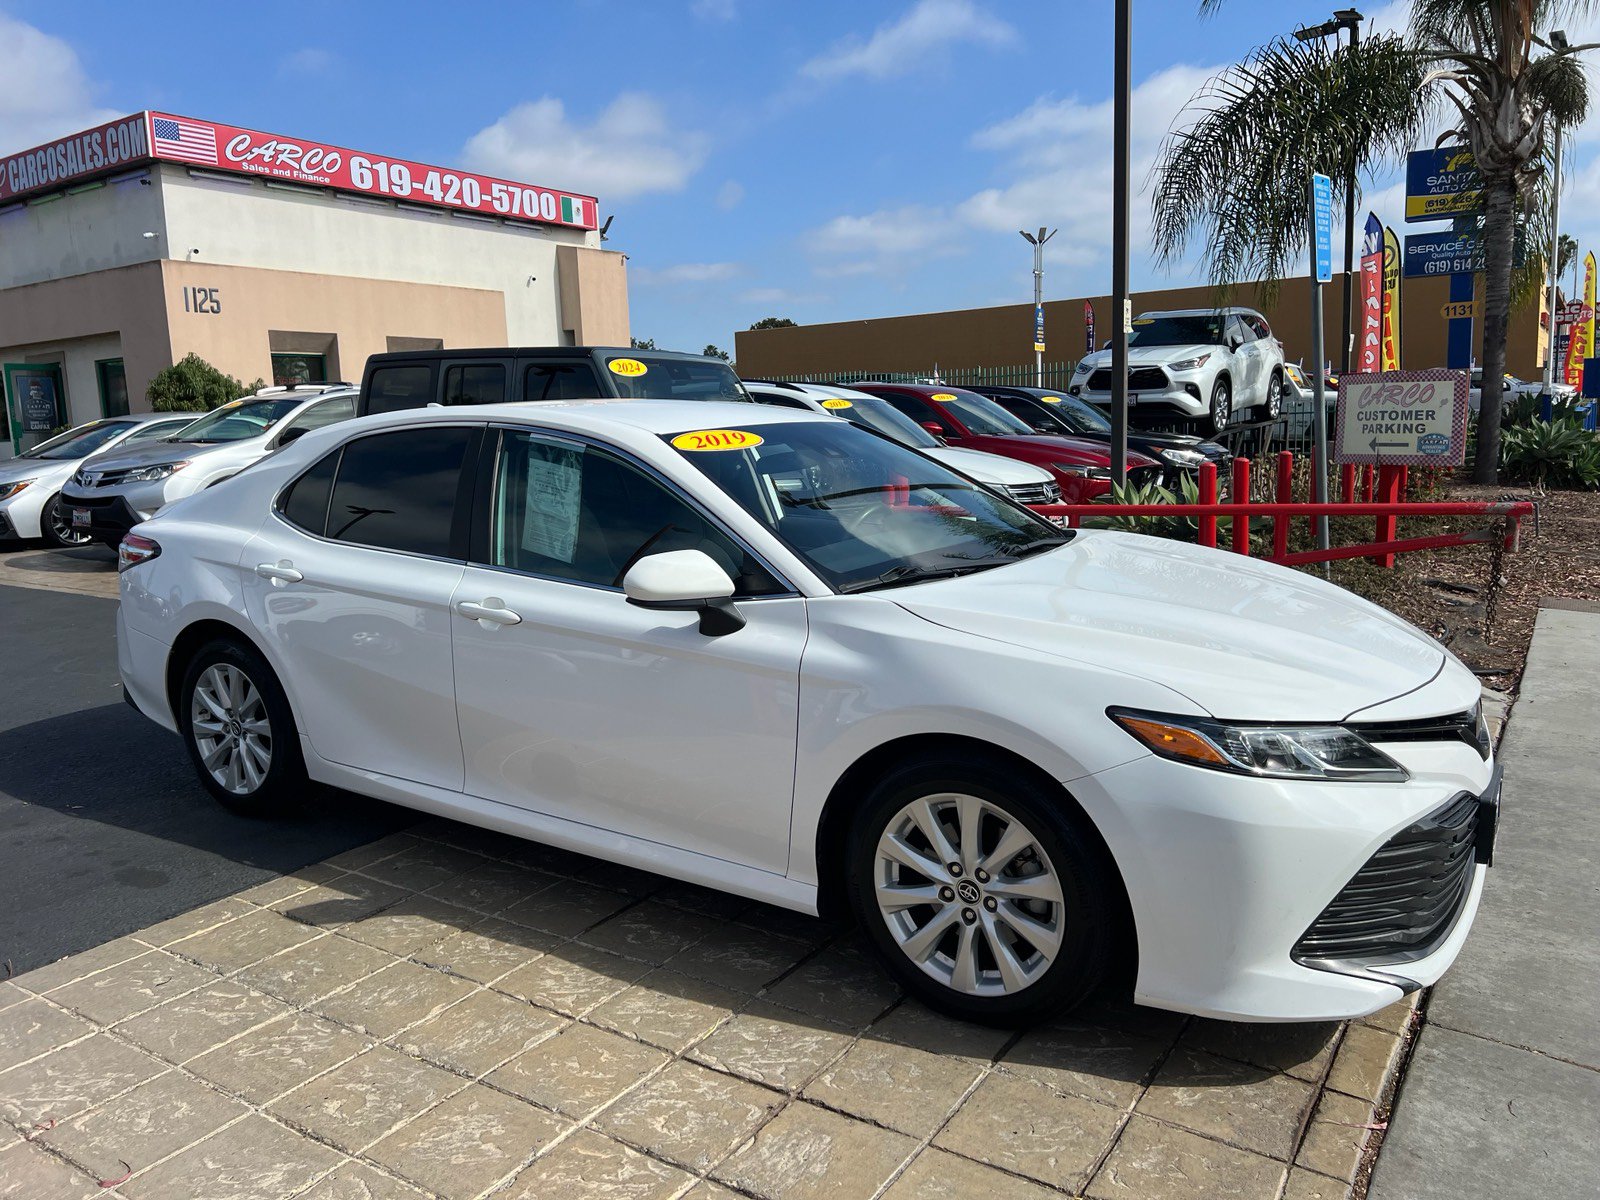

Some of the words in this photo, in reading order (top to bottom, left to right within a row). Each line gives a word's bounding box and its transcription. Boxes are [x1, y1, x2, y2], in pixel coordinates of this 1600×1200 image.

[8, 118, 147, 193] CARCOSALES.COM
[225, 133, 342, 174] CARCO
[241, 161, 270, 173] Sales
[272, 168, 291, 177] and
[293, 170, 331, 183] Finance
[350, 155, 557, 221] 619-420-5700
[1408, 241, 1464, 255] SERVICE
[1431, 251, 1455, 259] Quality
[1424, 260, 1451, 274] (619)
[1453, 258, 1472, 271] 614
[183, 286, 222, 315] 1125
[1444, 303, 1473, 317] 1131
[616, 361, 641, 374] 2024
[1358, 383, 1436, 409] CARCO
[1357, 409, 1436, 421] CUSTOMER
[1362, 423, 1427, 434] PARKING
[689, 432, 747, 449] 2019
